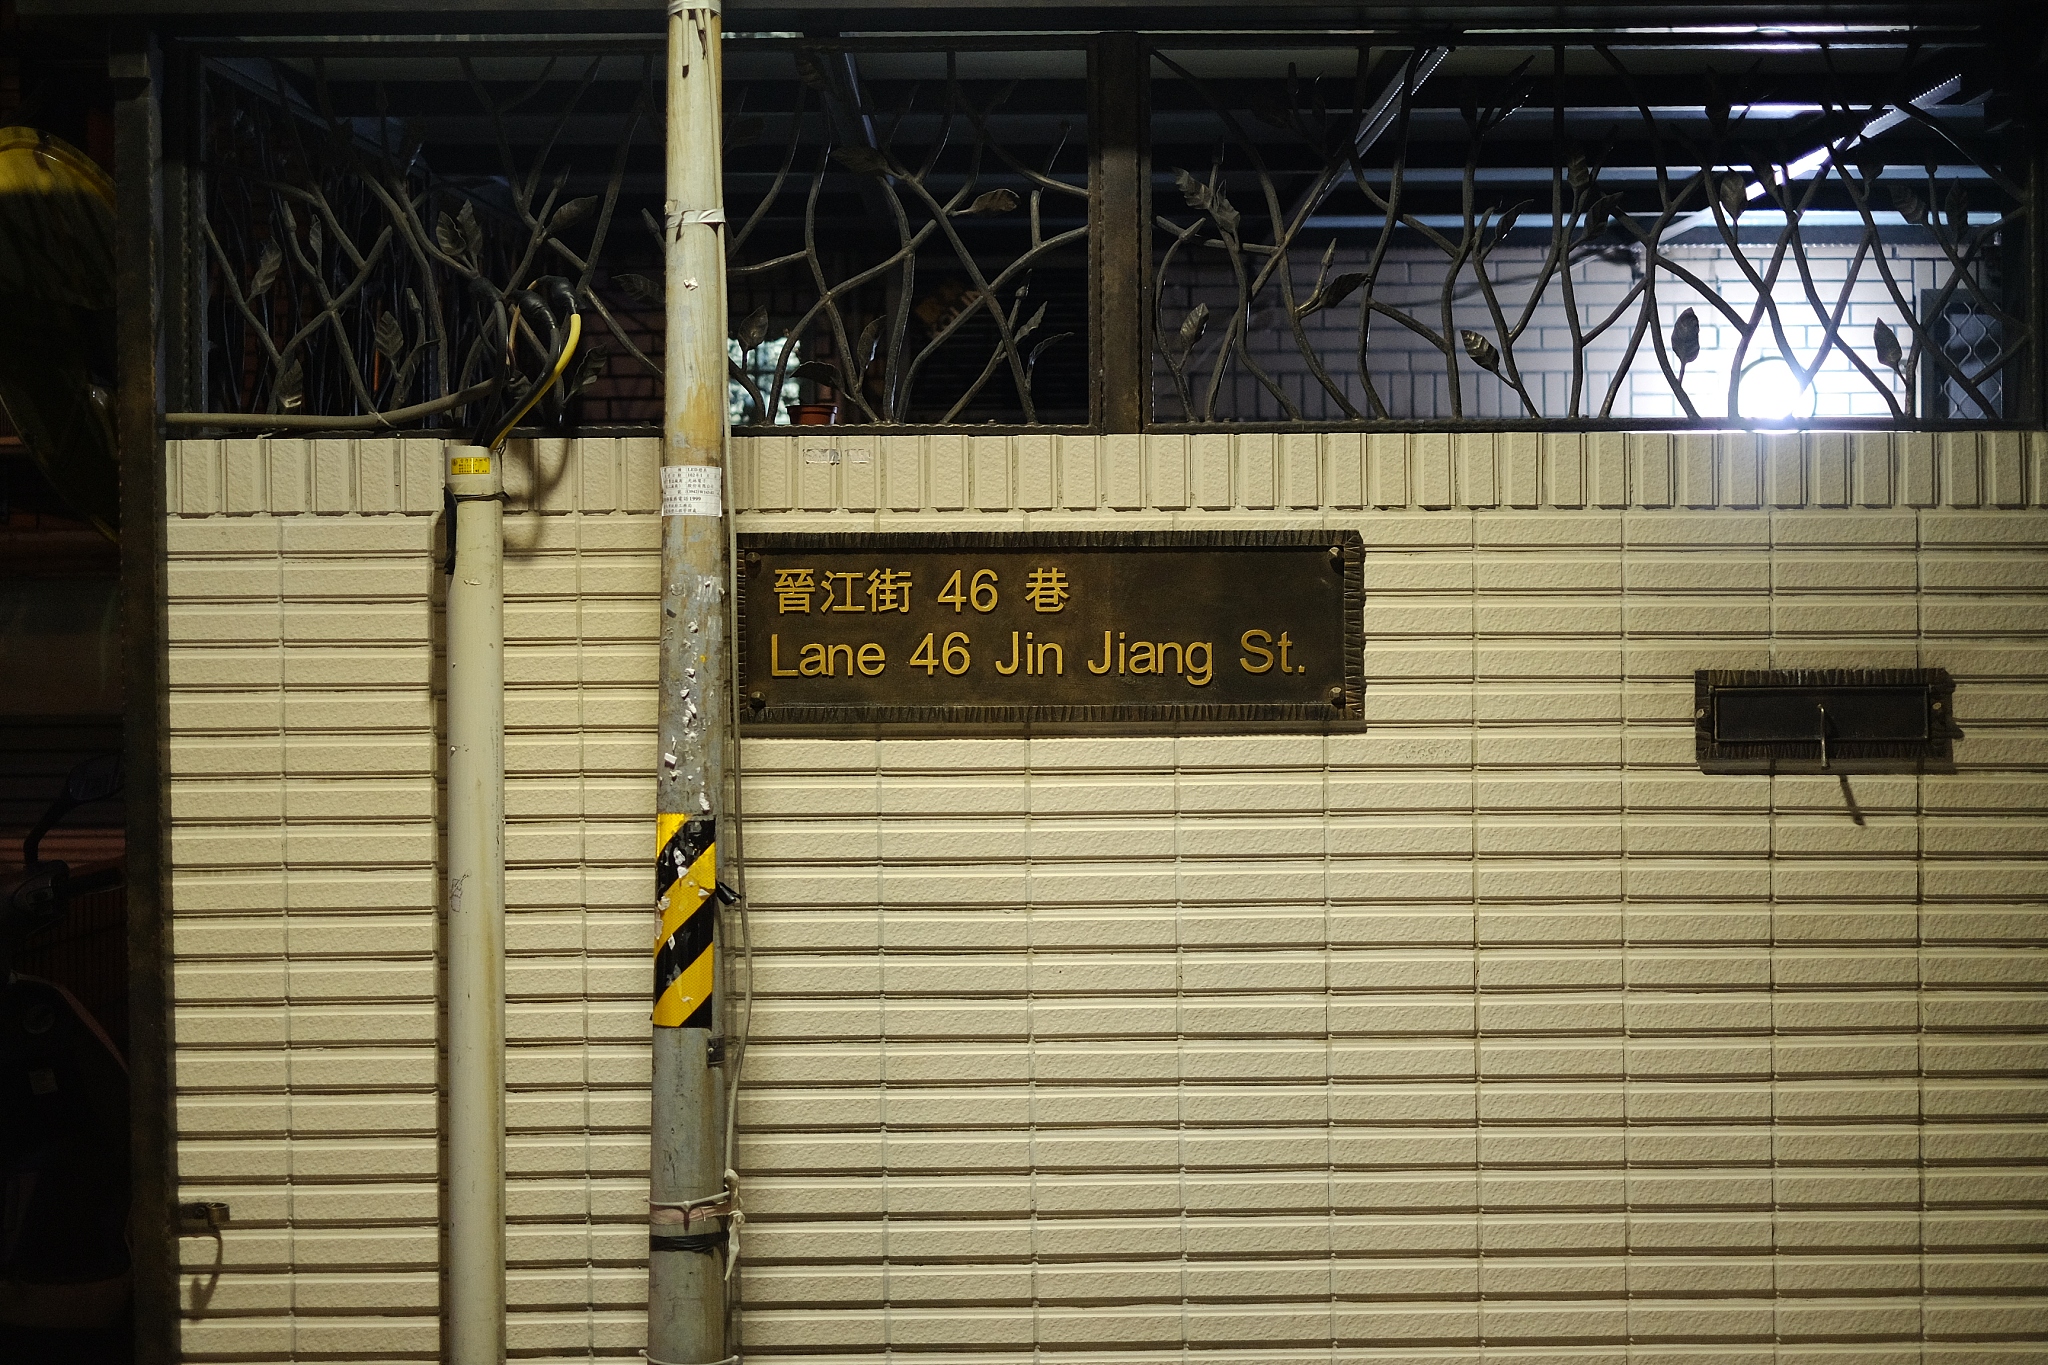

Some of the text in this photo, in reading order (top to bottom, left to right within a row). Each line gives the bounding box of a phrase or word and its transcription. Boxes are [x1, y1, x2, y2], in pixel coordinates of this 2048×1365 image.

[773, 567, 1070, 614] 晉江街 46 巷
[771, 629, 1306, 686] Lane 46 Jin Jiang St.
